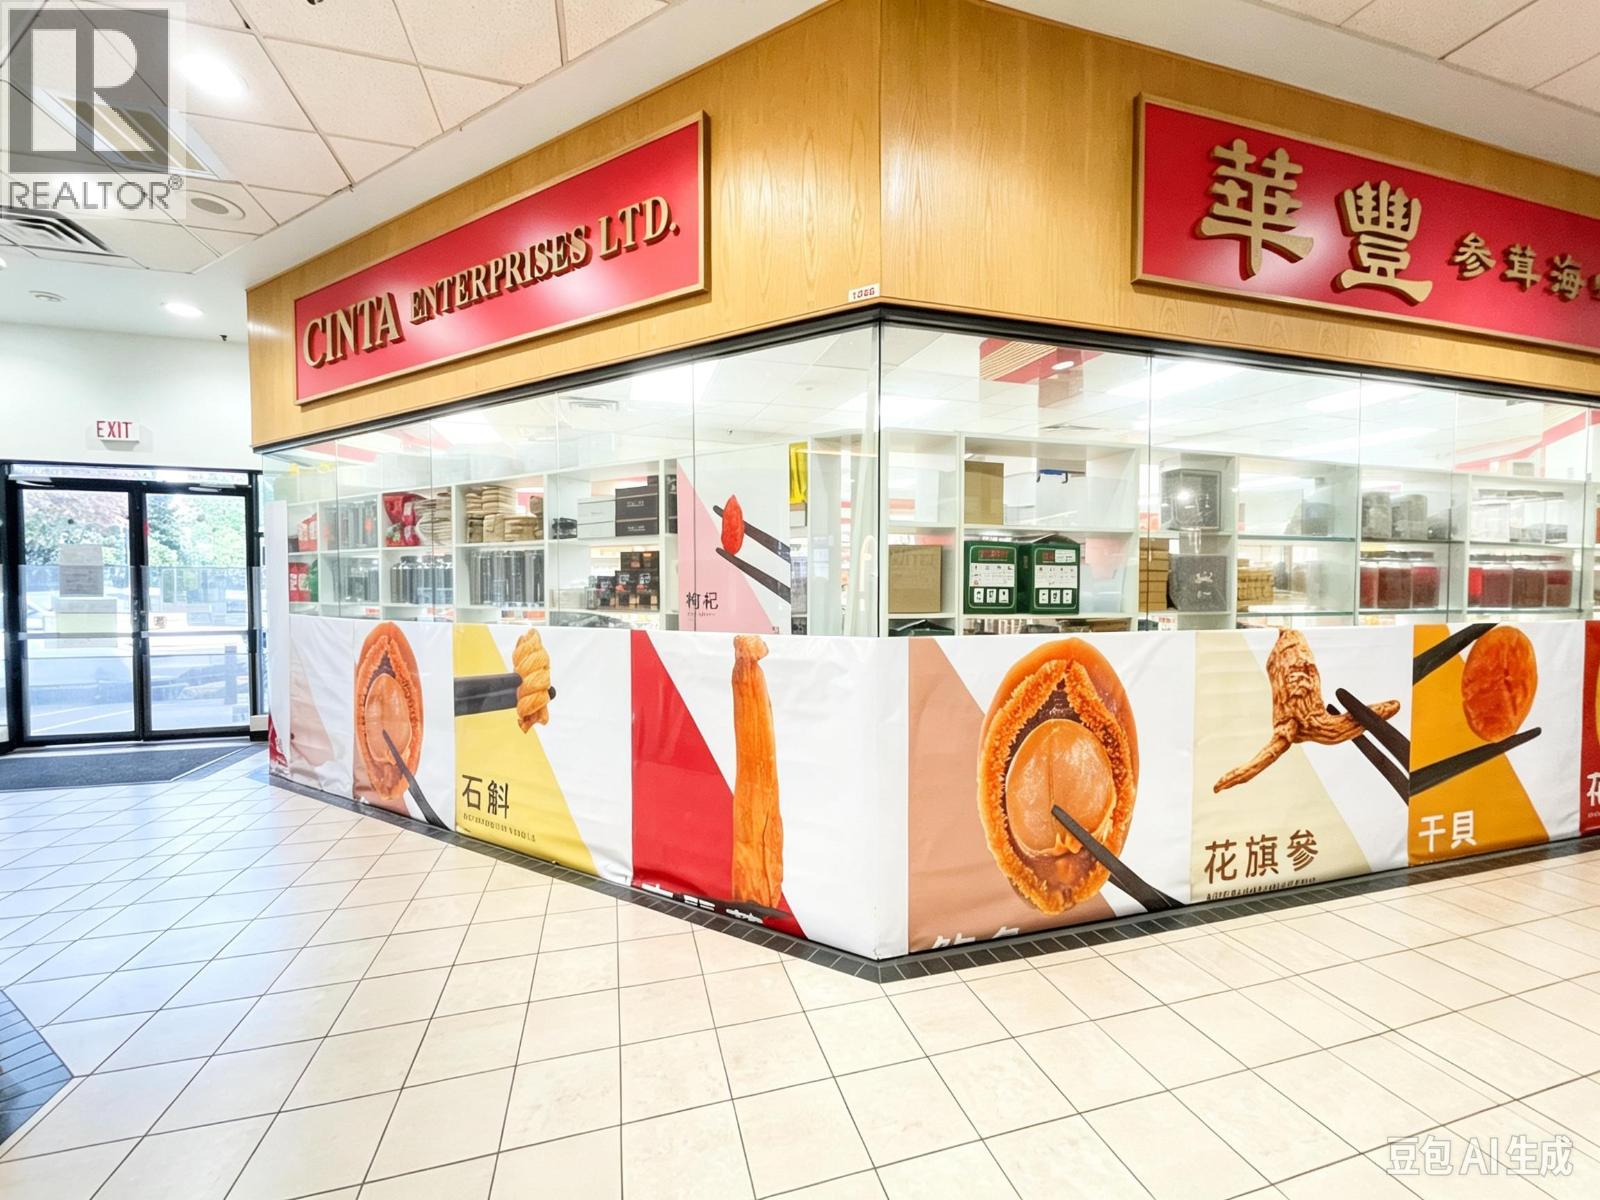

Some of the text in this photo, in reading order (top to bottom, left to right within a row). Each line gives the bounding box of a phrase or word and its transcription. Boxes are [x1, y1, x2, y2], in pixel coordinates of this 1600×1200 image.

[1197, 138, 1433, 305] 華豐
[302, 195, 681, 369] CINTA ENTERPRISES LTD.
[96, 420, 133, 439] EXIT
[461, 774, 510, 820] 石斛
[1417, 809, 1478, 853] 干貝
[1203, 829, 1319, 885] 花旗參
